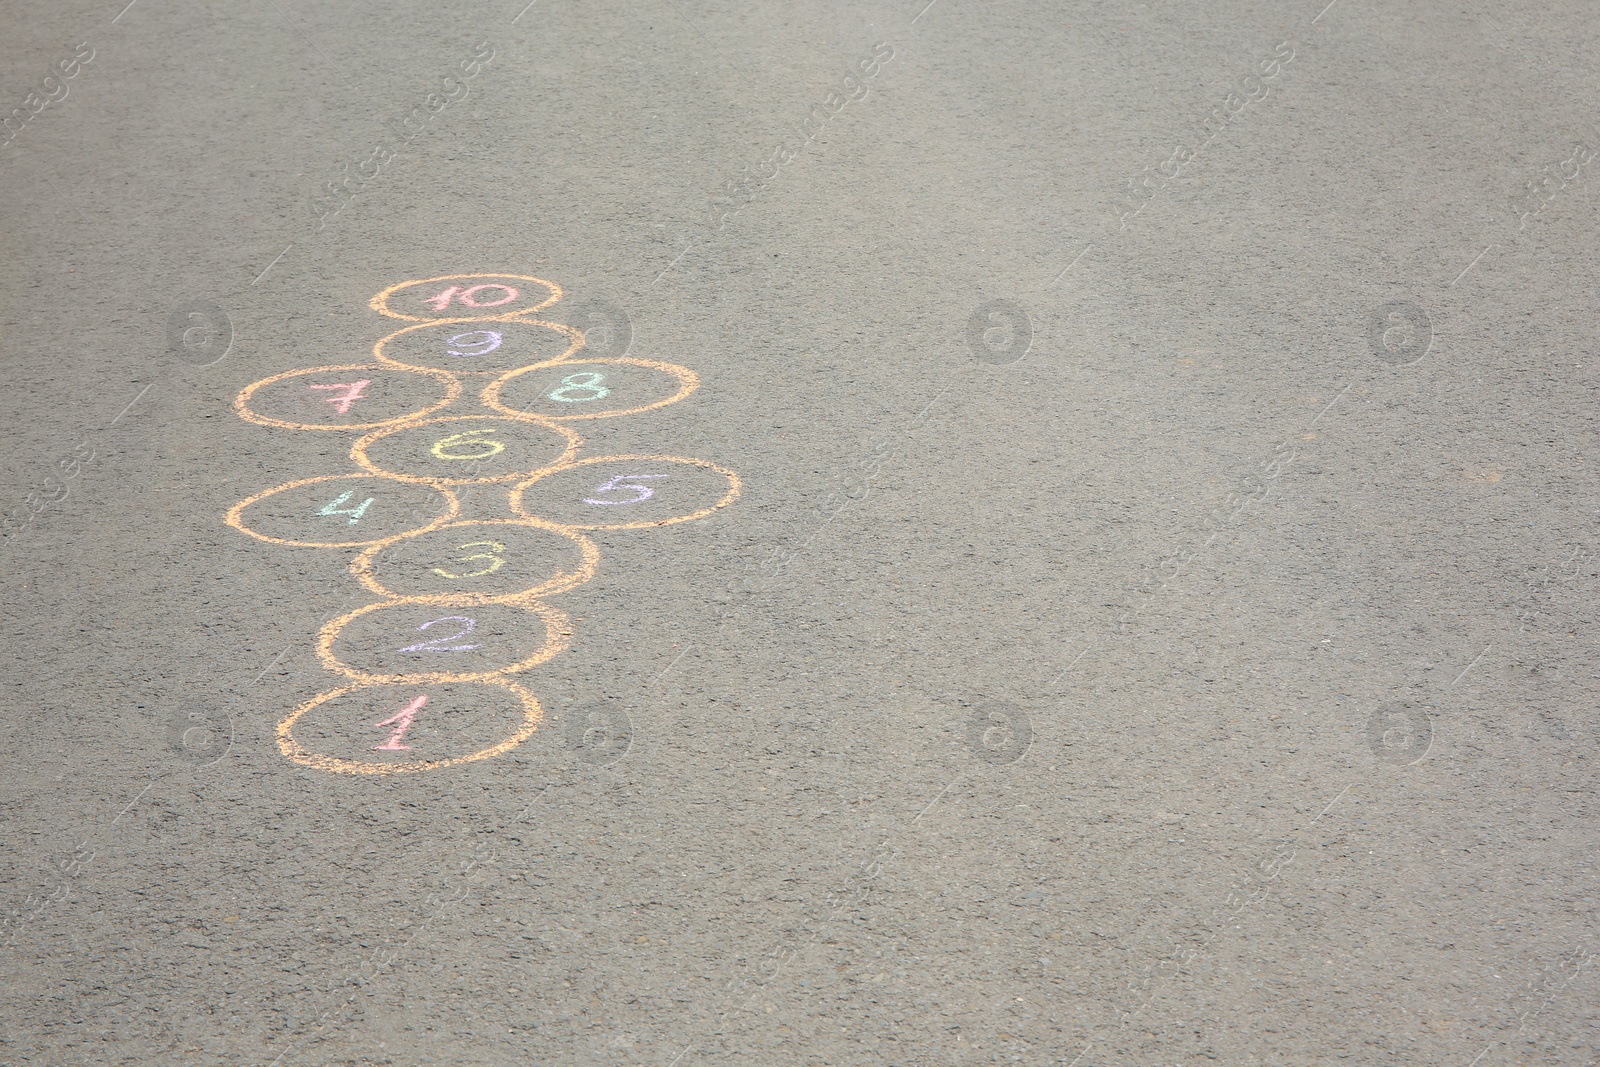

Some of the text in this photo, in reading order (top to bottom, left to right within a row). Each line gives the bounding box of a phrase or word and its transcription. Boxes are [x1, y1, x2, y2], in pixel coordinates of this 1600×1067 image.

[425, 284, 520, 312] 10
[446, 331, 502, 357] 9
[309, 379, 371, 415] 7
[547, 372, 612, 402] 8
[430, 428, 506, 460] 6
[315, 488, 376, 525] 4
[582, 473, 669, 506] 5
[433, 540, 507, 579] 3
[399, 615, 484, 653] 2
[372, 694, 428, 751] 1
